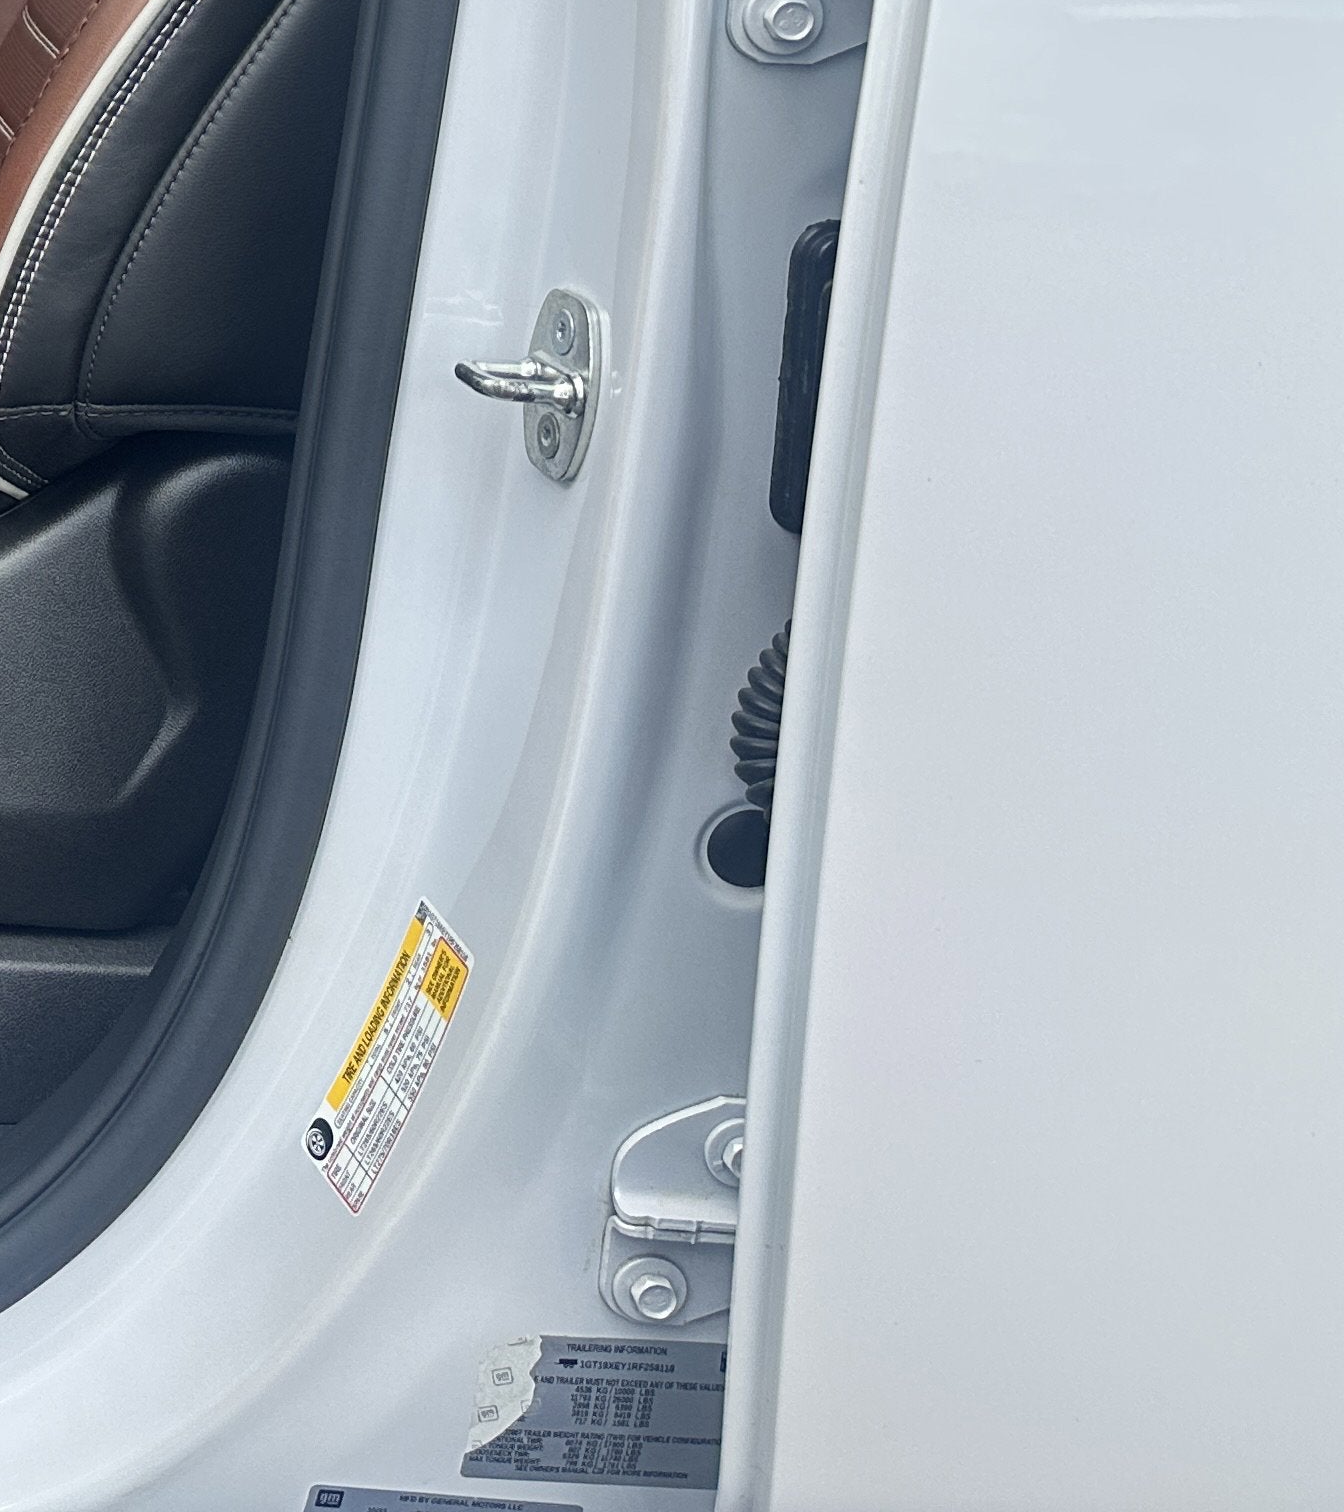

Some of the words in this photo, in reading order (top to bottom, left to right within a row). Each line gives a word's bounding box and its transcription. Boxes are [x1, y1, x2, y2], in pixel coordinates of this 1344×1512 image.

[342, 1061, 357, 1083] TIRE
[353, 1043, 366, 1066] AND
[361, 1006, 384, 1047] LOADING
[380, 950, 409, 1009] INFORMATION
[567, 1343, 612, 1354] TRAILERING
[614, 1345, 668, 1356] INFORMATION
[431, 1497, 470, 1507] GENERAL
[471, 1500, 507, 1509] MOTORS
